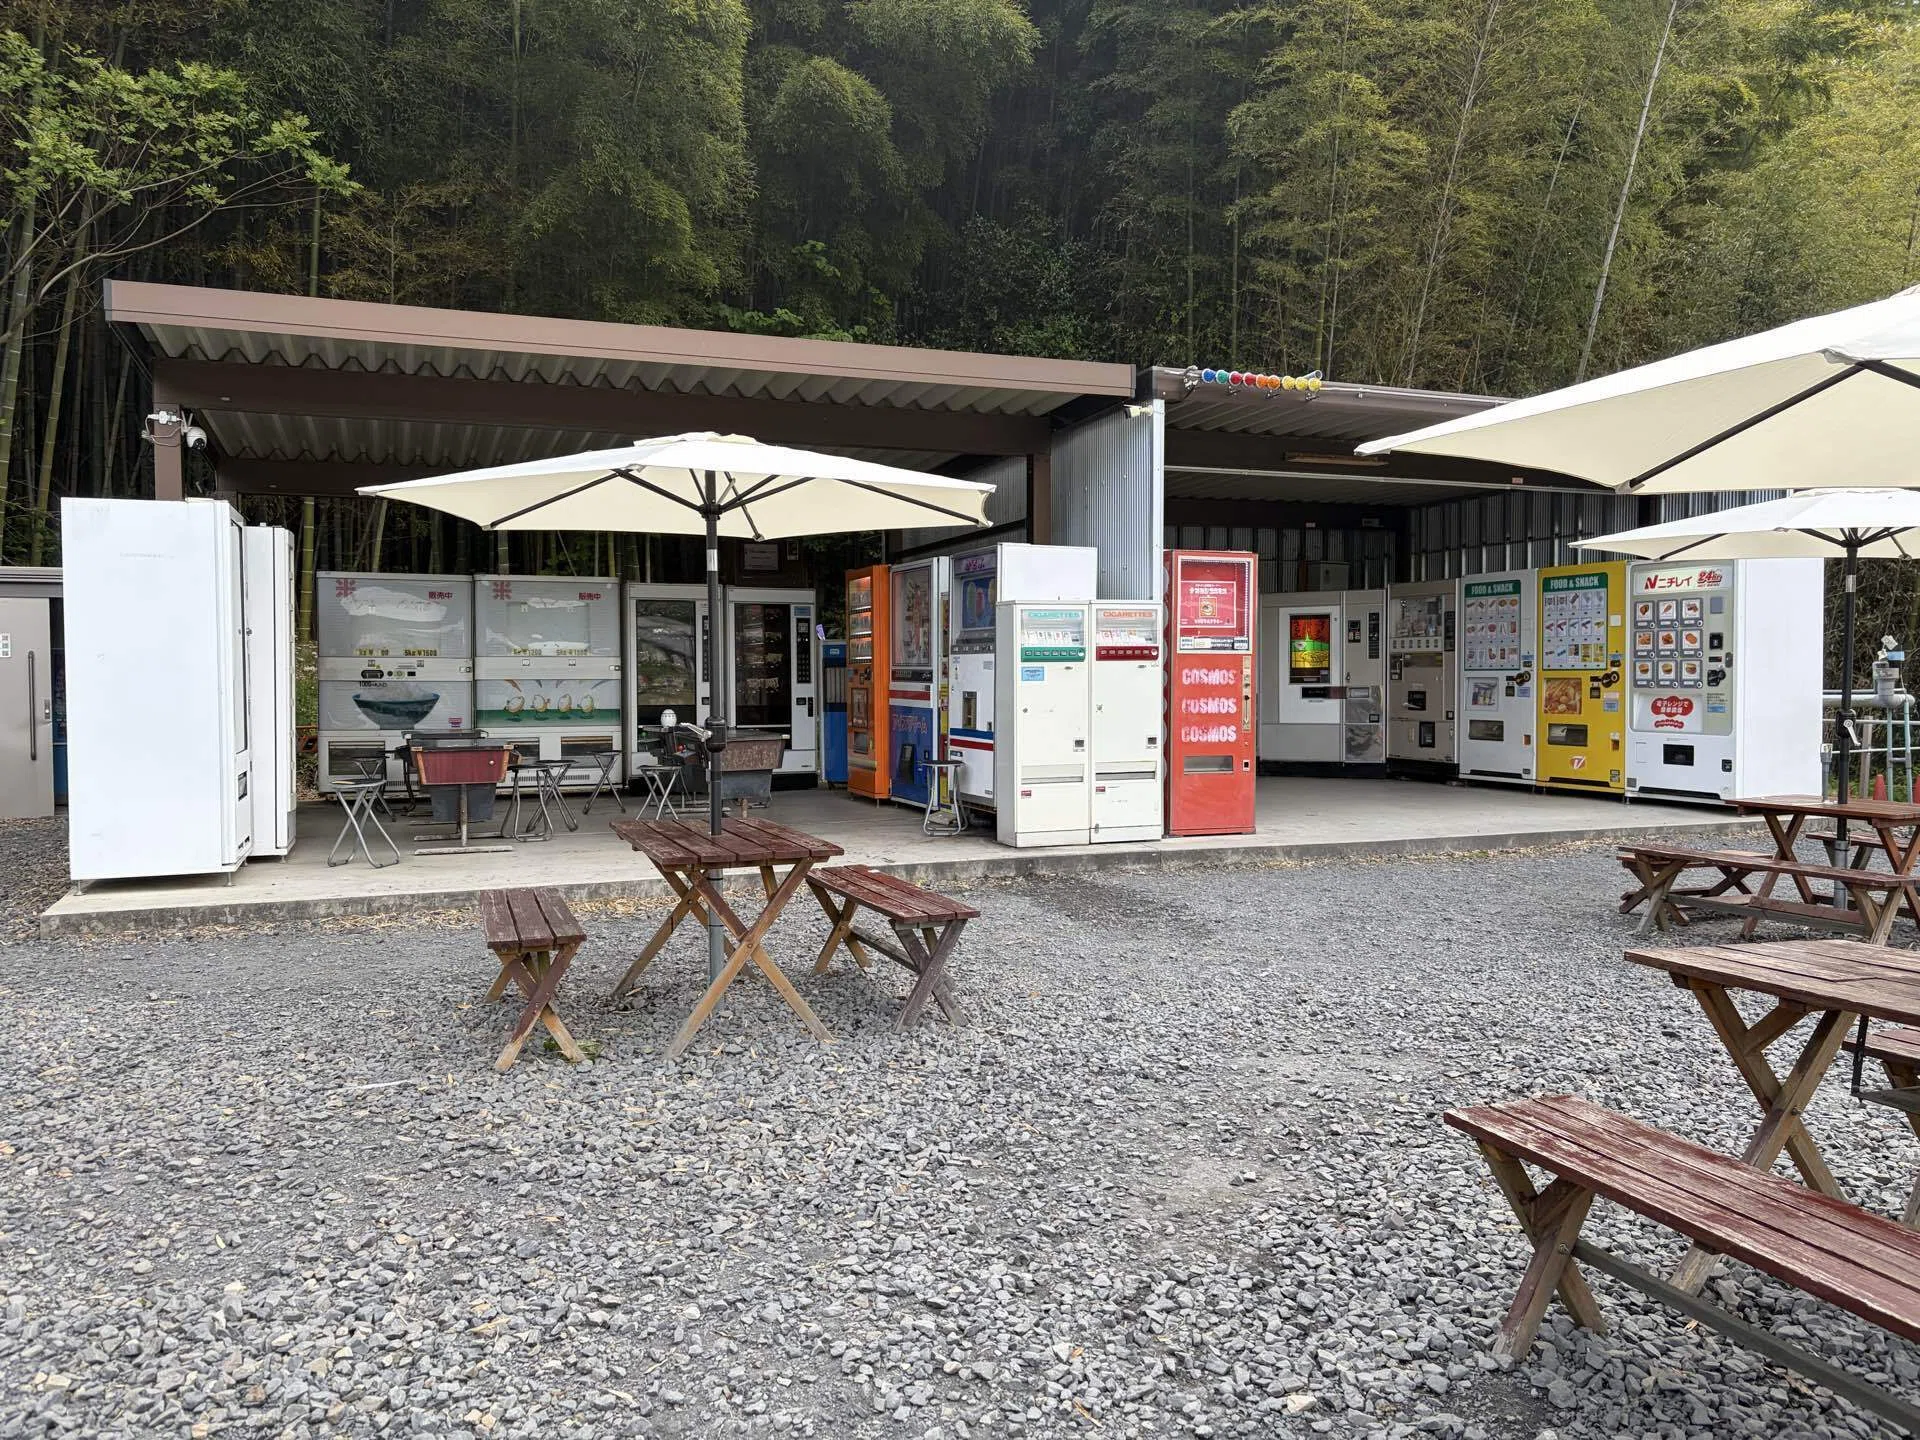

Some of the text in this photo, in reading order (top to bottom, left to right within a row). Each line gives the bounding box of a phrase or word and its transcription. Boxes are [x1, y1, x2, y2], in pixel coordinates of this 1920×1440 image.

[1471, 585, 1487, 594] FOOD
[1493, 583, 1514, 593] SNACK
[1550, 576, 1600, 589] FOOD & SNACK
[1658, 576, 1693, 589] ニチレイ
[1102, 610, 1154, 618] CIGARETTES
[1182, 668, 1237, 685] COSMOS
[1181, 697, 1237, 714] COSMOS
[1181, 725, 1237, 742] COSMOS
